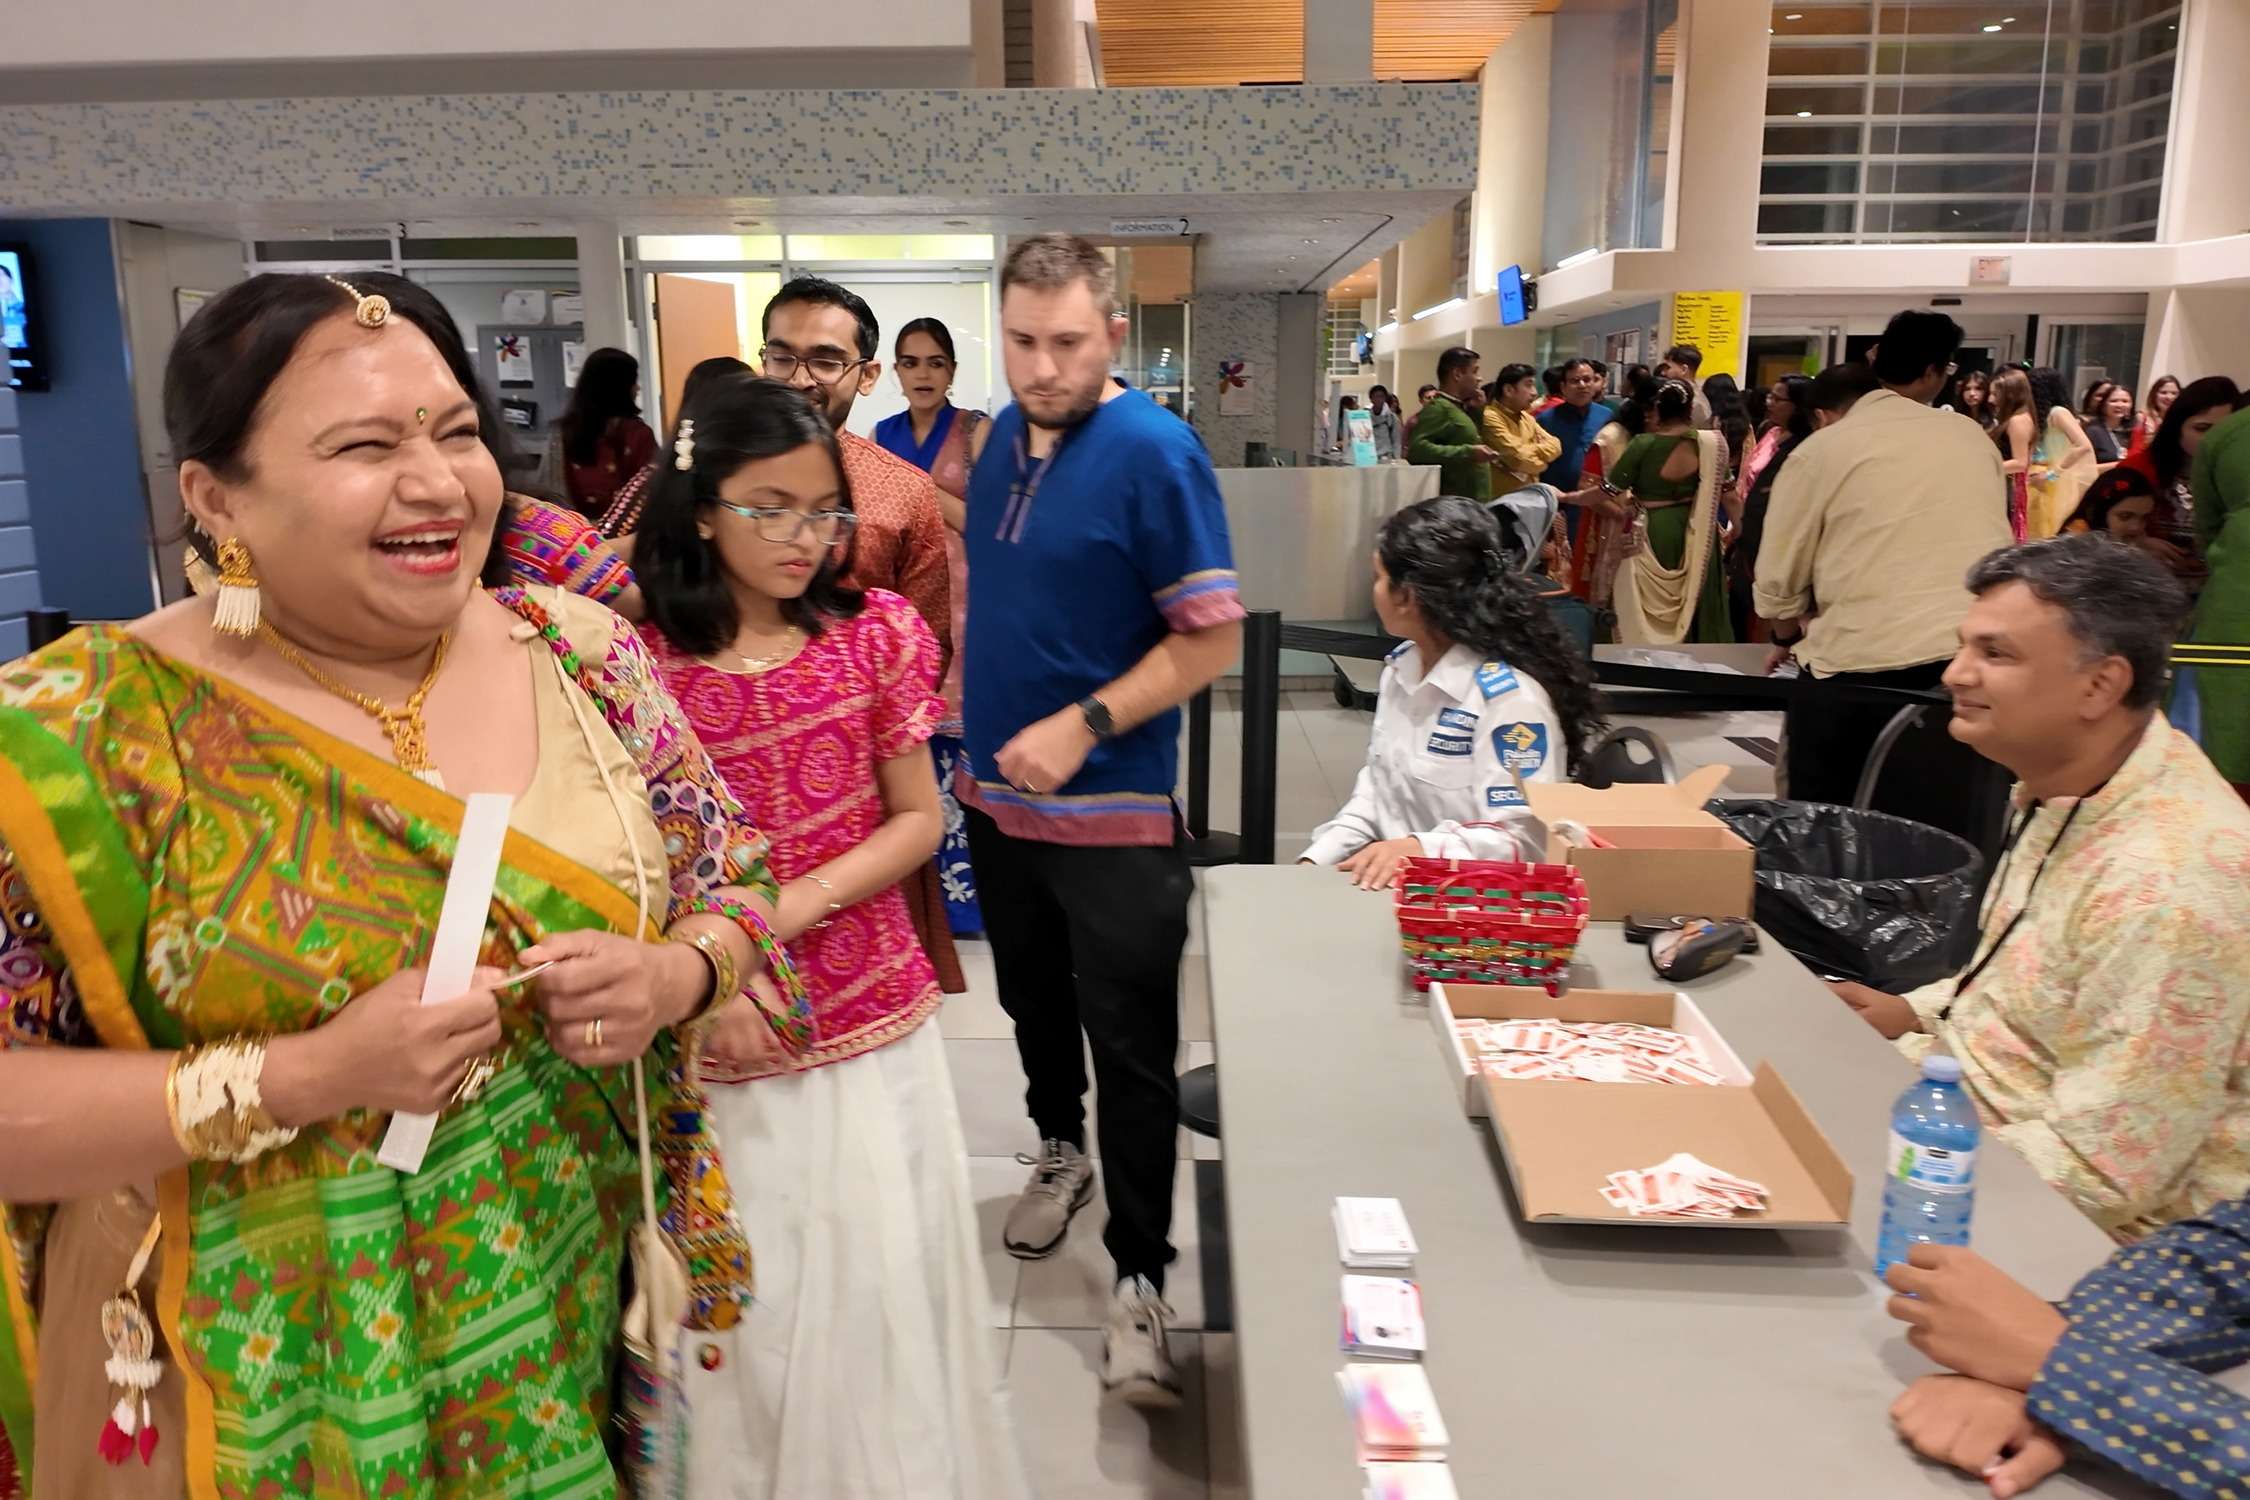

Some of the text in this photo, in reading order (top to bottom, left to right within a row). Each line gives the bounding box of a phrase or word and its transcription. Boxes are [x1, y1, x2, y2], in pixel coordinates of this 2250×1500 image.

[397, 222, 407, 239] 3
[1113, 218, 1190, 236] INFORMATION 2
